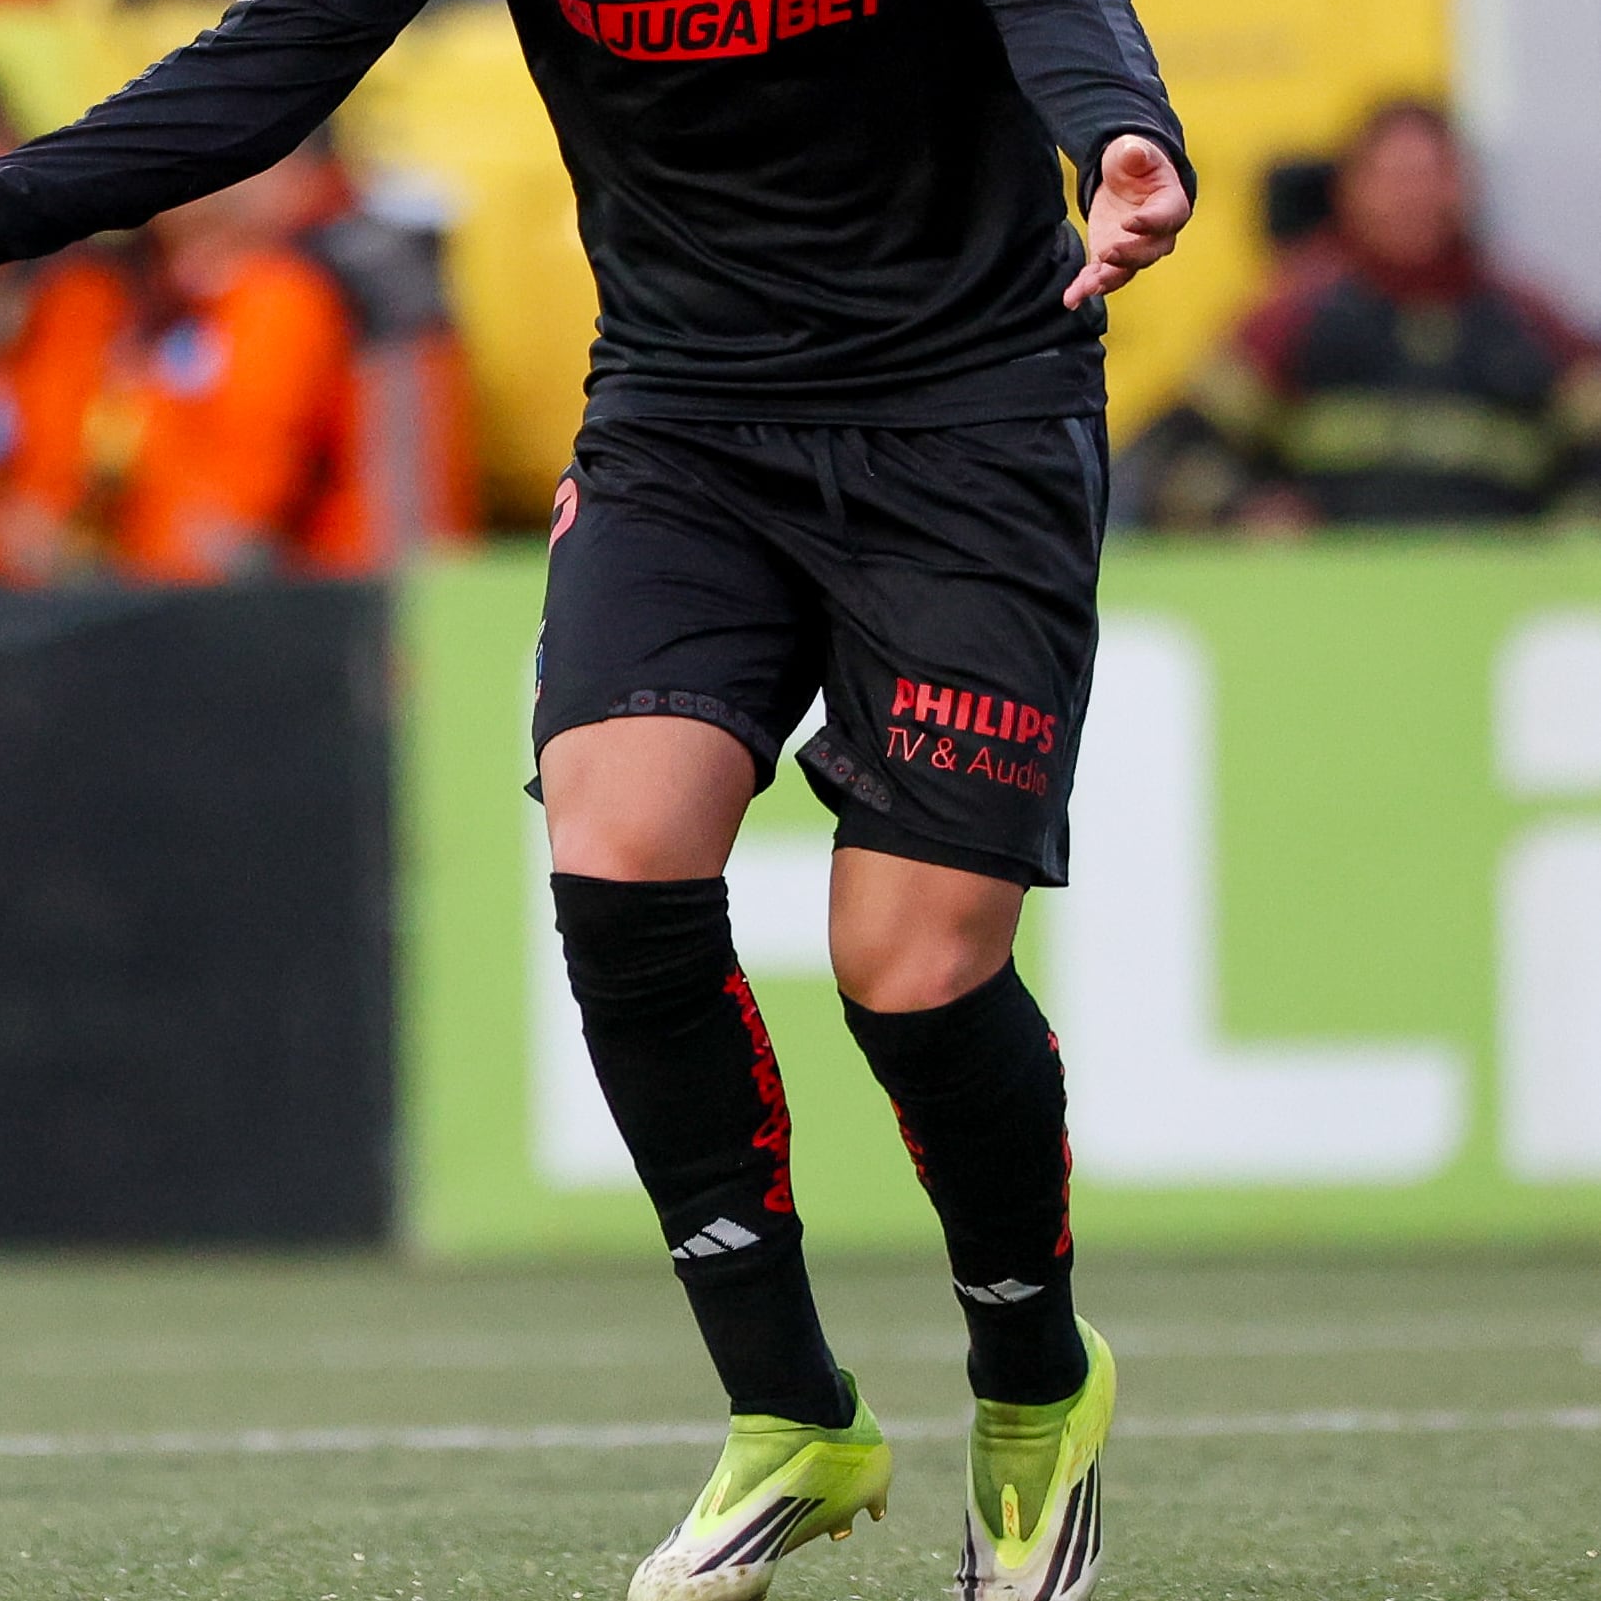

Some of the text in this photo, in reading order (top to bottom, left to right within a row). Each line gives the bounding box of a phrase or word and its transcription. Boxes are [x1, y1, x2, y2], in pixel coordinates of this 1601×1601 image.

[891, 677, 1056, 754] PHILIPS
[887, 727, 1049, 798] TV & Audio
